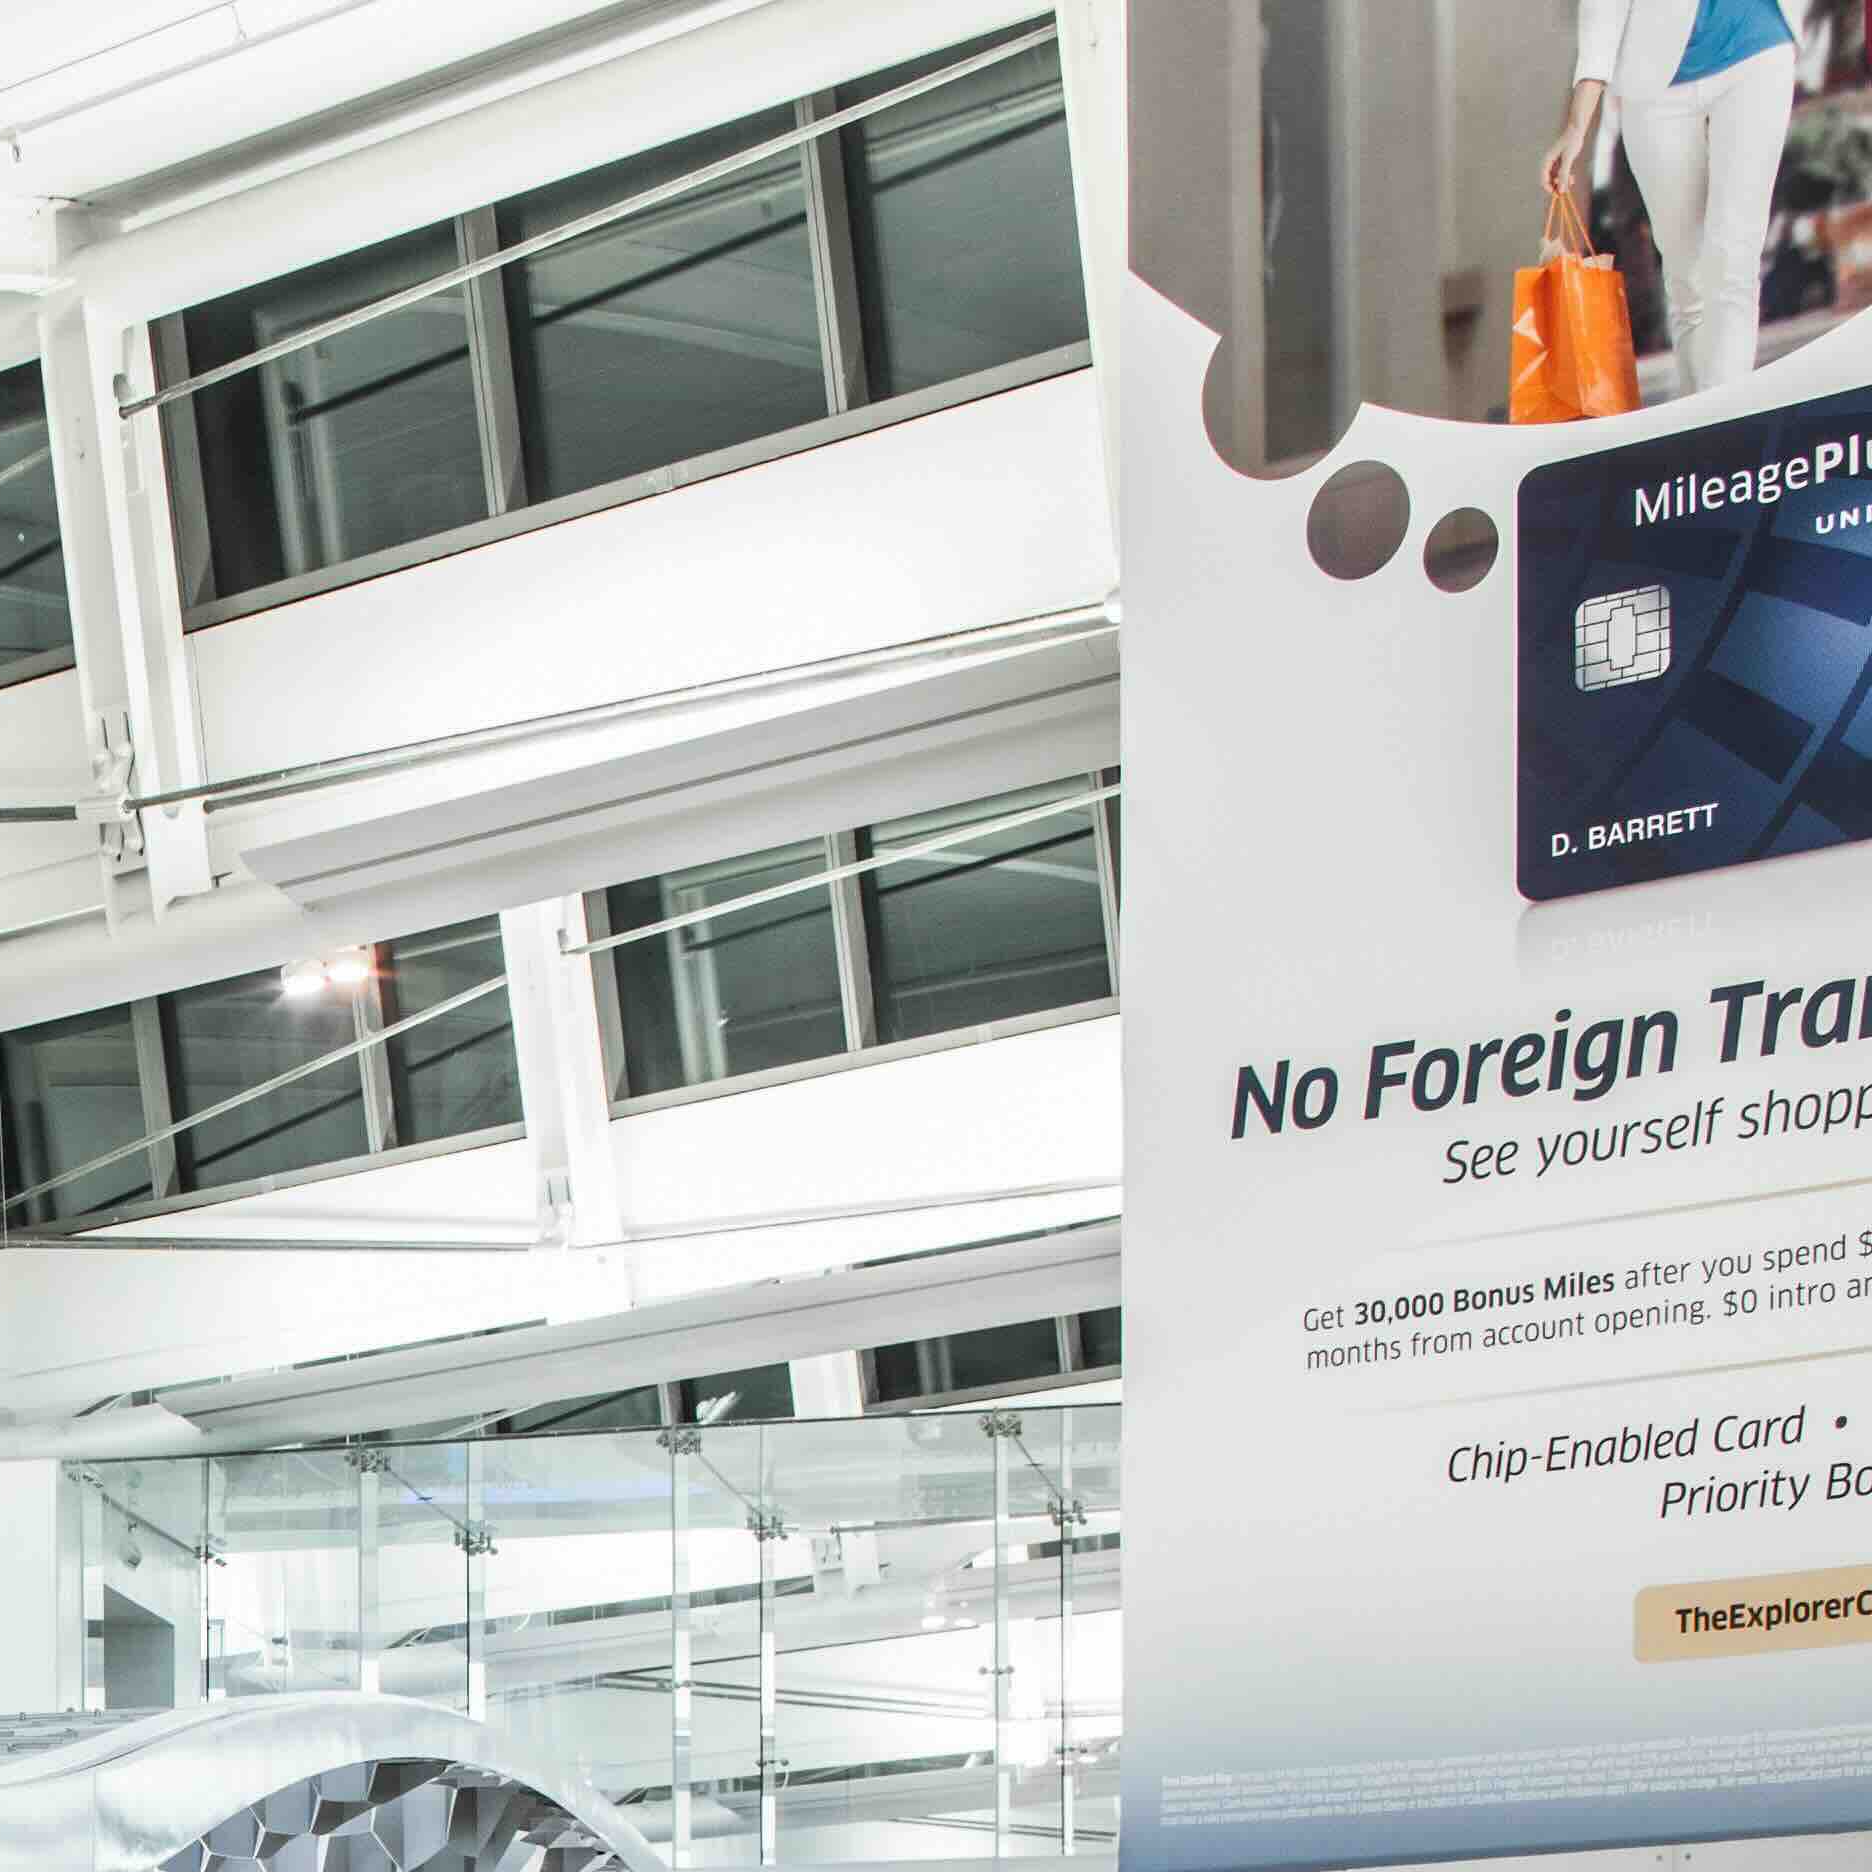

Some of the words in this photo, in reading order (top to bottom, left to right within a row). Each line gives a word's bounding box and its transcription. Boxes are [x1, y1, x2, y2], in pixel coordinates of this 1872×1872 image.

[1634, 433, 1872, 527] MileagePl
[1551, 833, 1579, 857] D.
[1588, 802, 1719, 850] BARRETT
[1231, 1059, 1339, 1139] No
[1363, 1008, 1680, 1120] Foreign
[1709, 974, 1872, 1063] Tra
[1443, 1138, 1519, 1184] See
[1537, 1097, 1727, 1176] yourself
[1303, 1304, 1344, 1332] Get
[1355, 1291, 1445, 1326] 30,000
[1453, 1282, 1535, 1313] Bonus
[1543, 1271, 1615, 1301] Miles
[1625, 1261, 1691, 1290] after
[1702, 1253, 1753, 1284] you
[1763, 1234, 1847, 1273] spend
[1307, 1337, 1402, 1370] months
[1412, 1329, 1473, 1357] from
[1482, 1313, 1585, 1348] account
[1594, 1299, 1712, 1334] opening.
[1723, 1288, 1758, 1317] $0
[1770, 1280, 1836, 1310] intro
[1448, 1418, 1700, 1484] Chip-Enabled
[1713, 1404, 1806, 1453] Card
[1661, 1469, 1810, 1519] Priority
[1675, 1588, 1872, 1634] TheExplorerC
